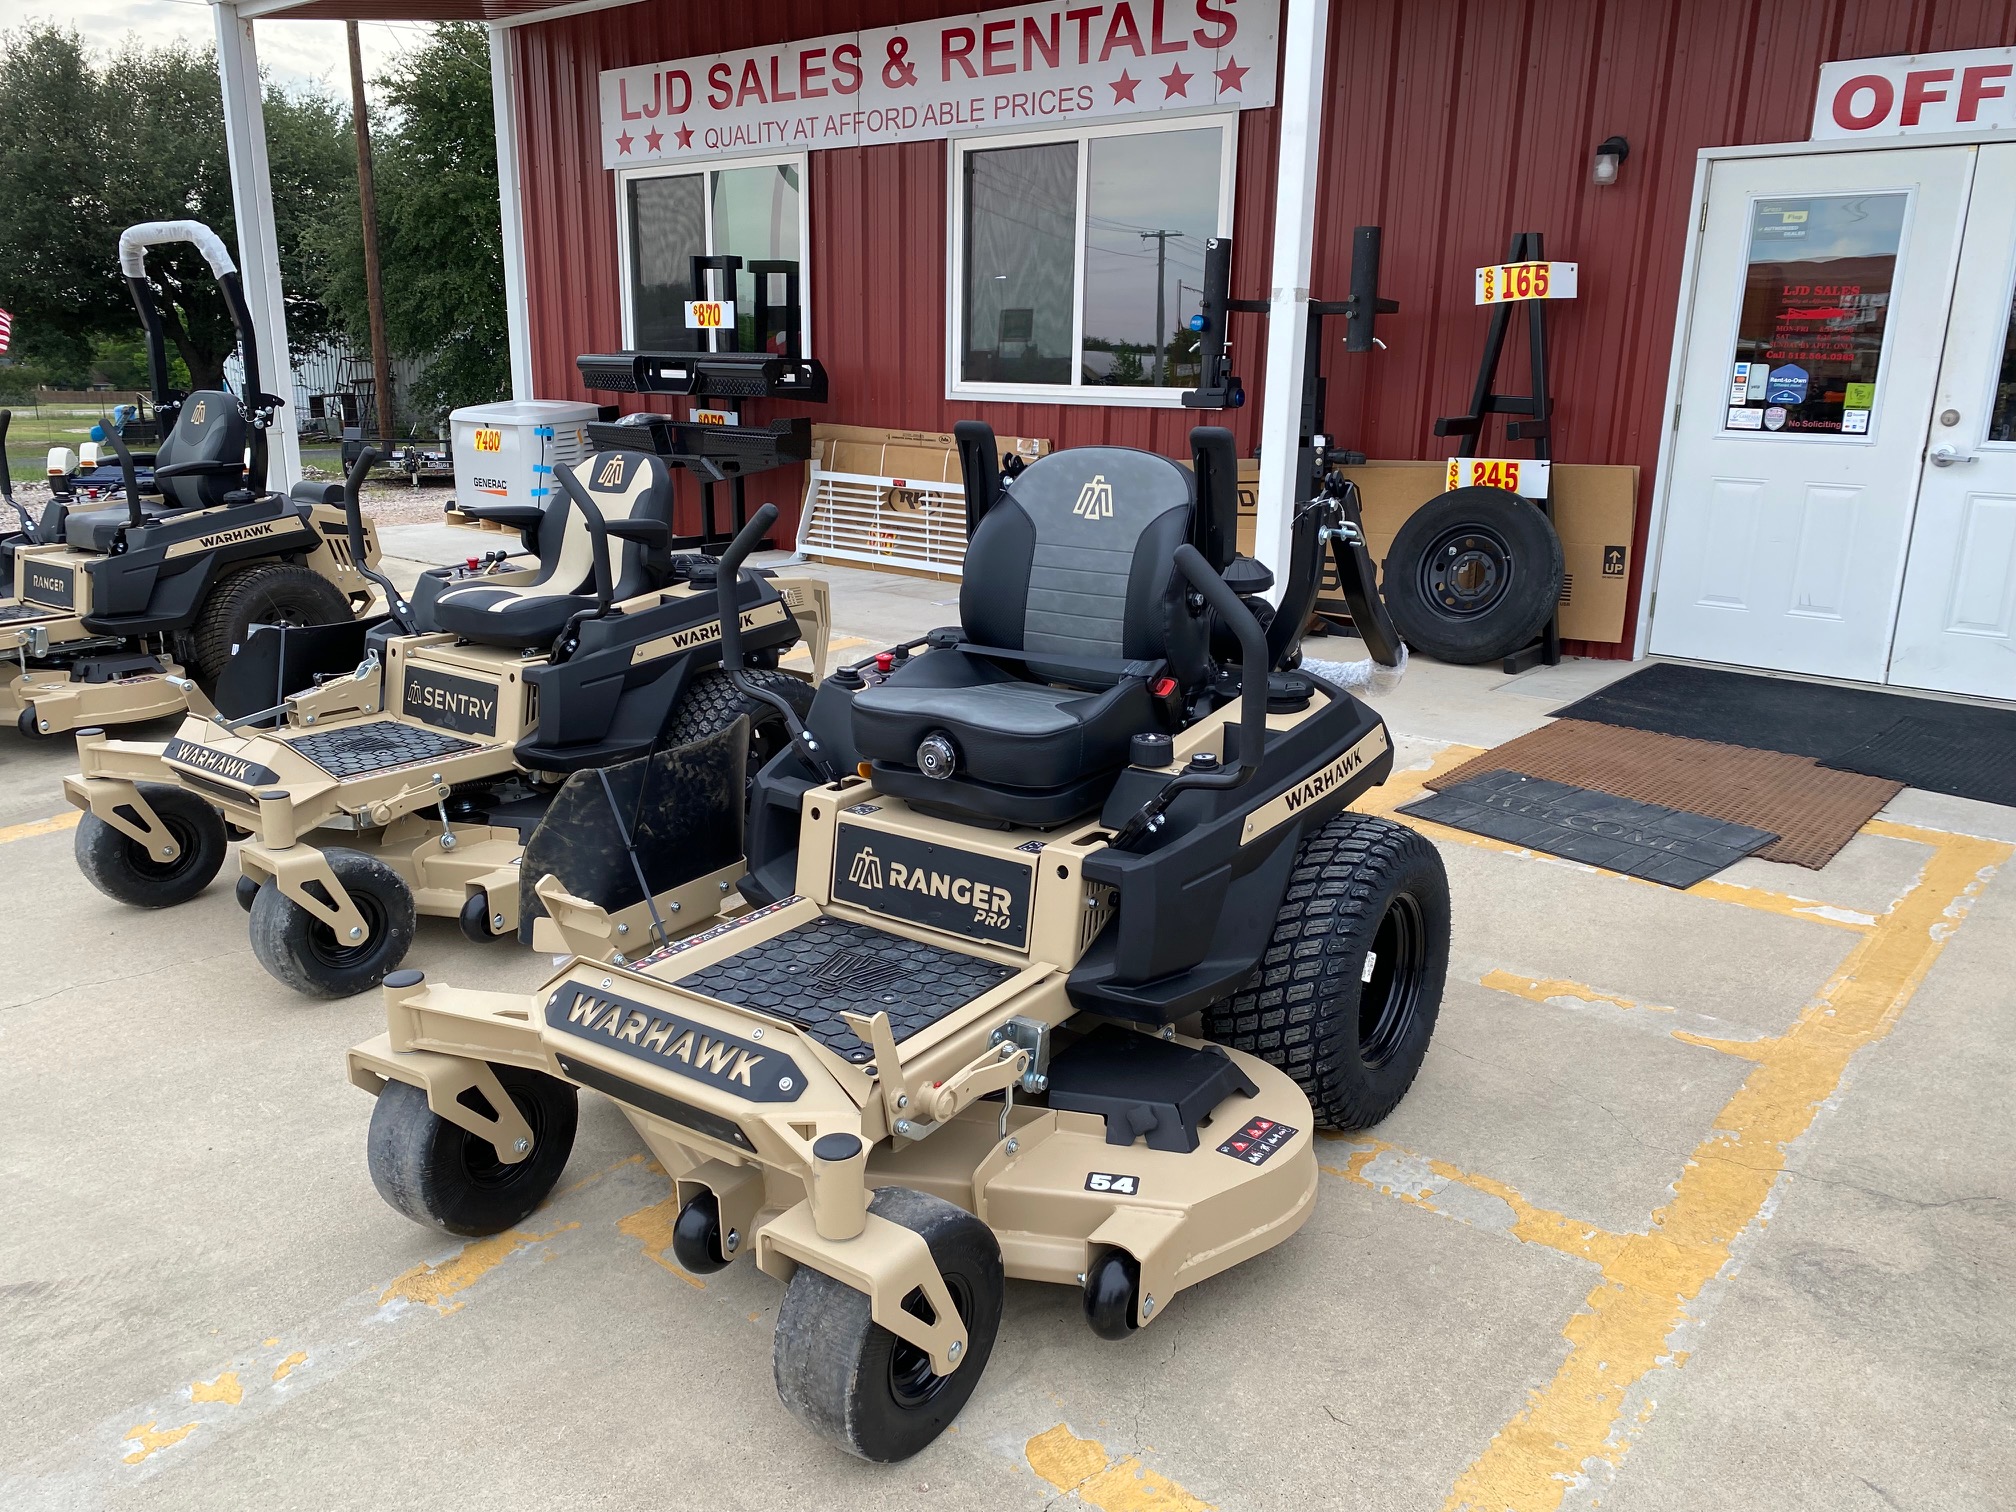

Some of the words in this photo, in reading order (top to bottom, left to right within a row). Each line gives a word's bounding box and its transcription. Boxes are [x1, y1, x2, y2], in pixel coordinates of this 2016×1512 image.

[618, 69, 693, 121] LJD
[706, 43, 863, 110] SALES
[881, 36, 918, 89] &
[941, 0, 1239, 82] RENTALS
[705, 119, 789, 149] QUALITY
[793, 116, 819, 140] AT
[993, 85, 1094, 119] PRICES
[1502, 264, 1549, 299] 165
[1782, 286, 1810, 296] LJD
[1813, 286, 1861, 296] SALES
[1766, 351, 1786, 359] Call
[1788, 420, 1801, 428] No
[1802, 420, 1842, 430] Soliciting
[475, 430, 502, 451] 7480
[473, 477, 508, 490] GENERAC
[1473, 461, 1519, 493] 245
[199, 523, 274, 548] WARHAWK
[1605, 563, 1624, 574] UP
[33, 574, 64, 593] RANGER
[671, 613, 755, 648] WARHK
[423, 687, 494, 721] SENTRY
[175, 742, 253, 780] WARHAWK
[1284, 746, 1363, 812] WARHAWK
[889, 861, 1012, 916] RANGER
[973, 909, 1011, 930] PRO
[566, 991, 766, 1088] WARHAWK
[1089, 1173, 1134, 1194] 54
